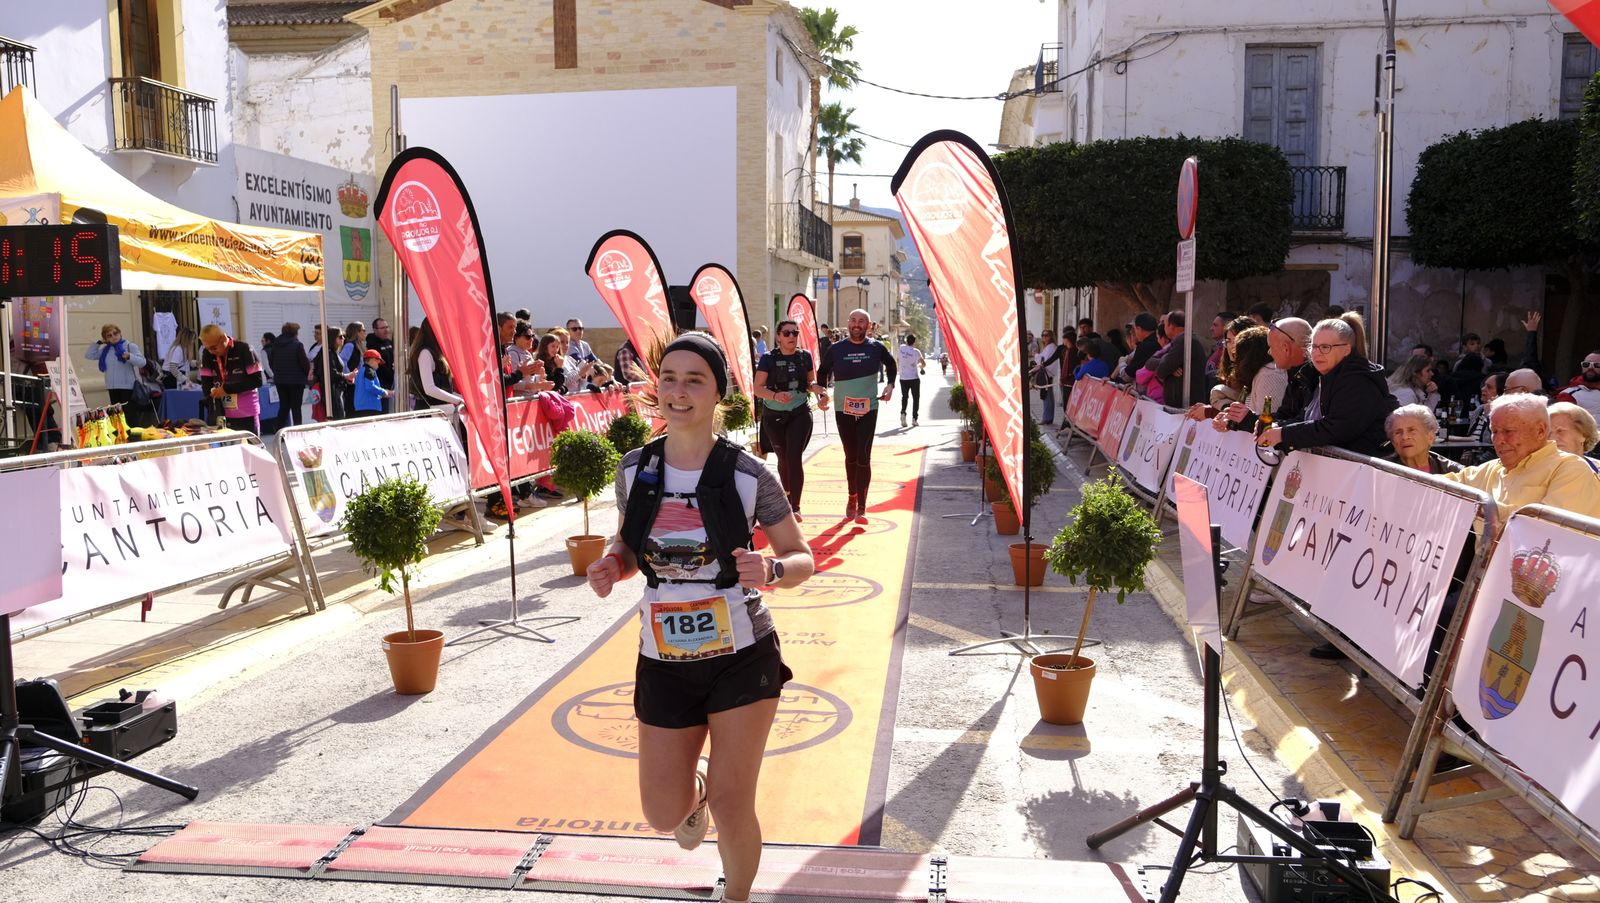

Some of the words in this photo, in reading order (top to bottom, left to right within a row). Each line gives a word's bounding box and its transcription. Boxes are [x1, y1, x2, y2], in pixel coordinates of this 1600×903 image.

[245, 172, 332, 205] EXCELENTÍSIMO
[249, 202, 333, 231] AYUNTAMIENTO
[848, 401, 865, 409] 281
[335, 440, 432, 467] AYUNTAMIENTO
[436, 438, 452, 450] DE
[1252, 463, 1265, 481] DE
[72, 479, 230, 523] UNTAMIENTO
[237, 473, 259, 492] DE
[62, 496, 274, 576] ANTORIA
[1420, 540, 1444, 570] DE
[1287, 517, 1431, 632] CANTORIA
[663, 612, 715, 634] 182
[516, 816, 650, 833] antoria
